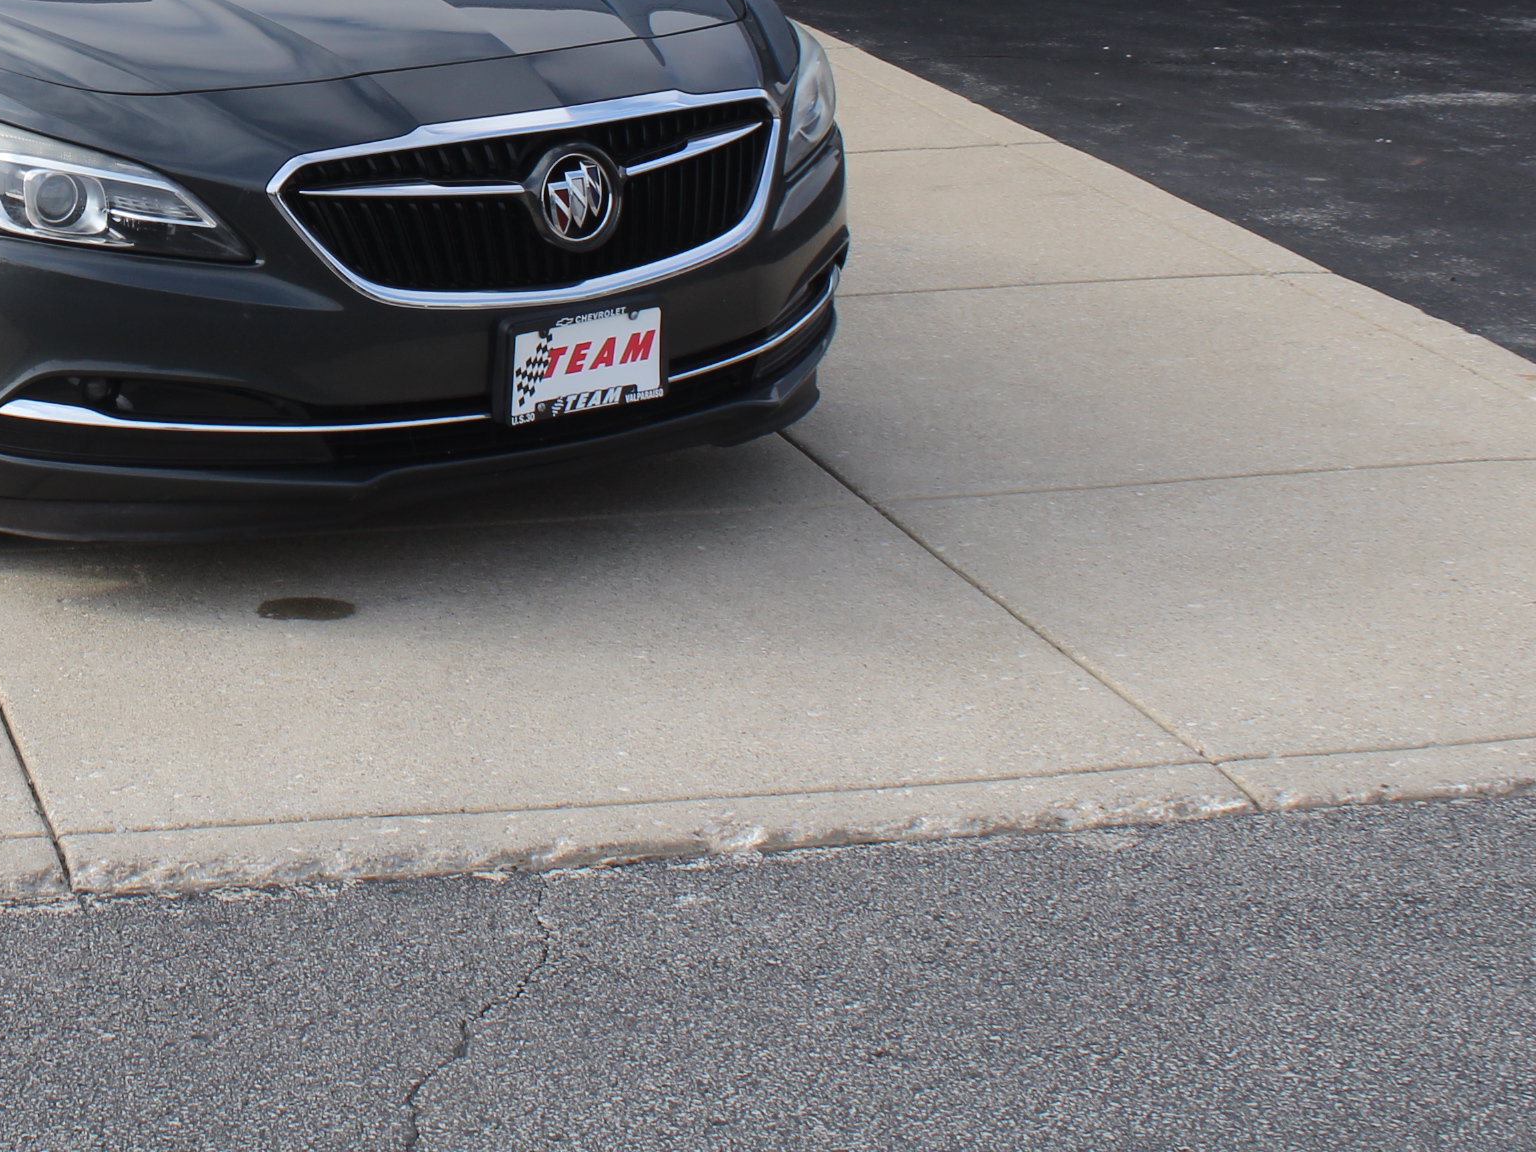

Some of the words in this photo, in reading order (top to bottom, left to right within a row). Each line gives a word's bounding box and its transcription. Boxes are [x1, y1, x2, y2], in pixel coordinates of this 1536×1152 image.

[575, 306, 627, 324] CHEVROLET
[542, 329, 656, 379] TEAM
[564, 385, 623, 414] TEAM
[624, 388, 664, 404] VALPARAISO
